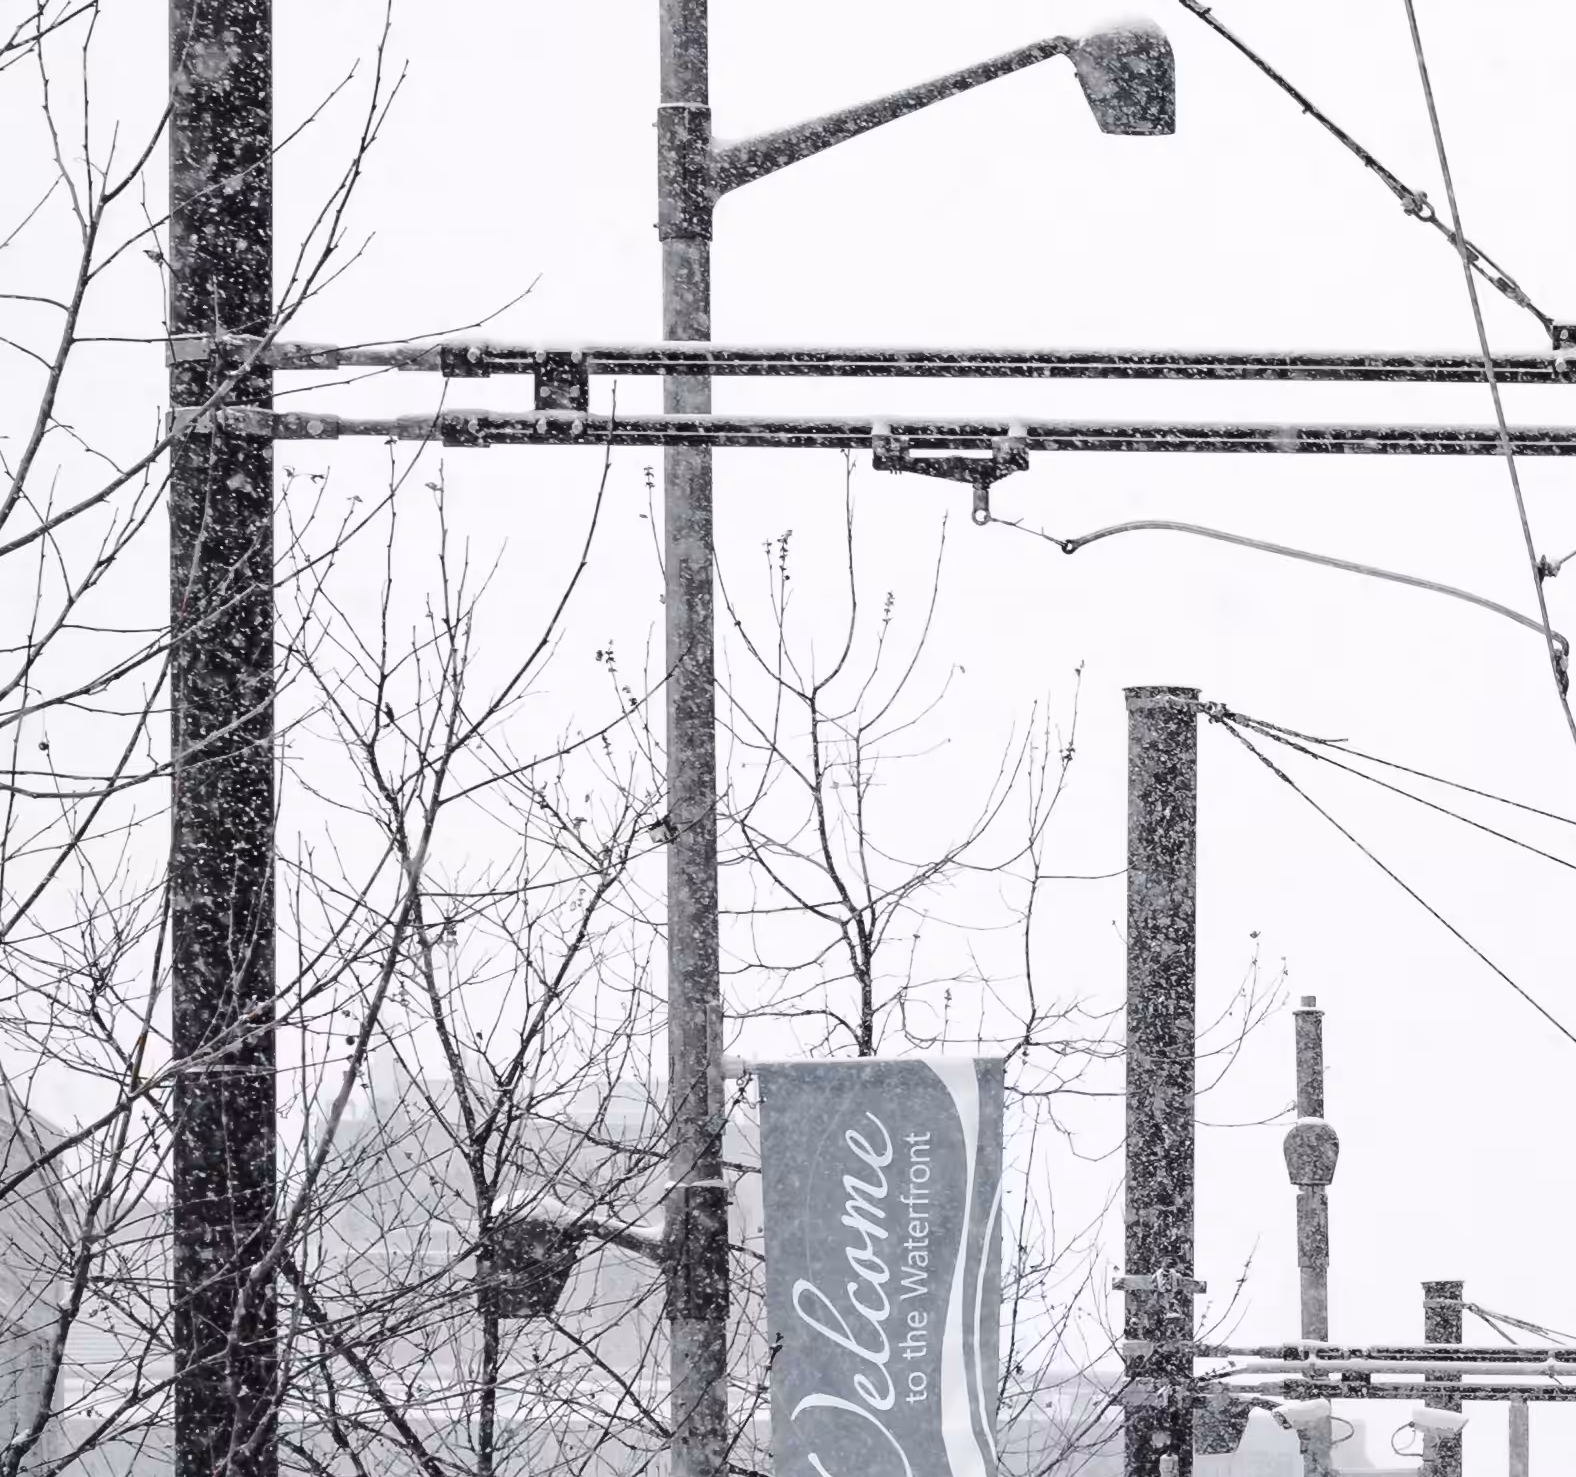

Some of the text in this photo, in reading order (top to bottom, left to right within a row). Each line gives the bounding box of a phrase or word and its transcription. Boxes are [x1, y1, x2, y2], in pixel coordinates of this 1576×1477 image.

[898, 1130, 932, 1404] to the Waterfront
